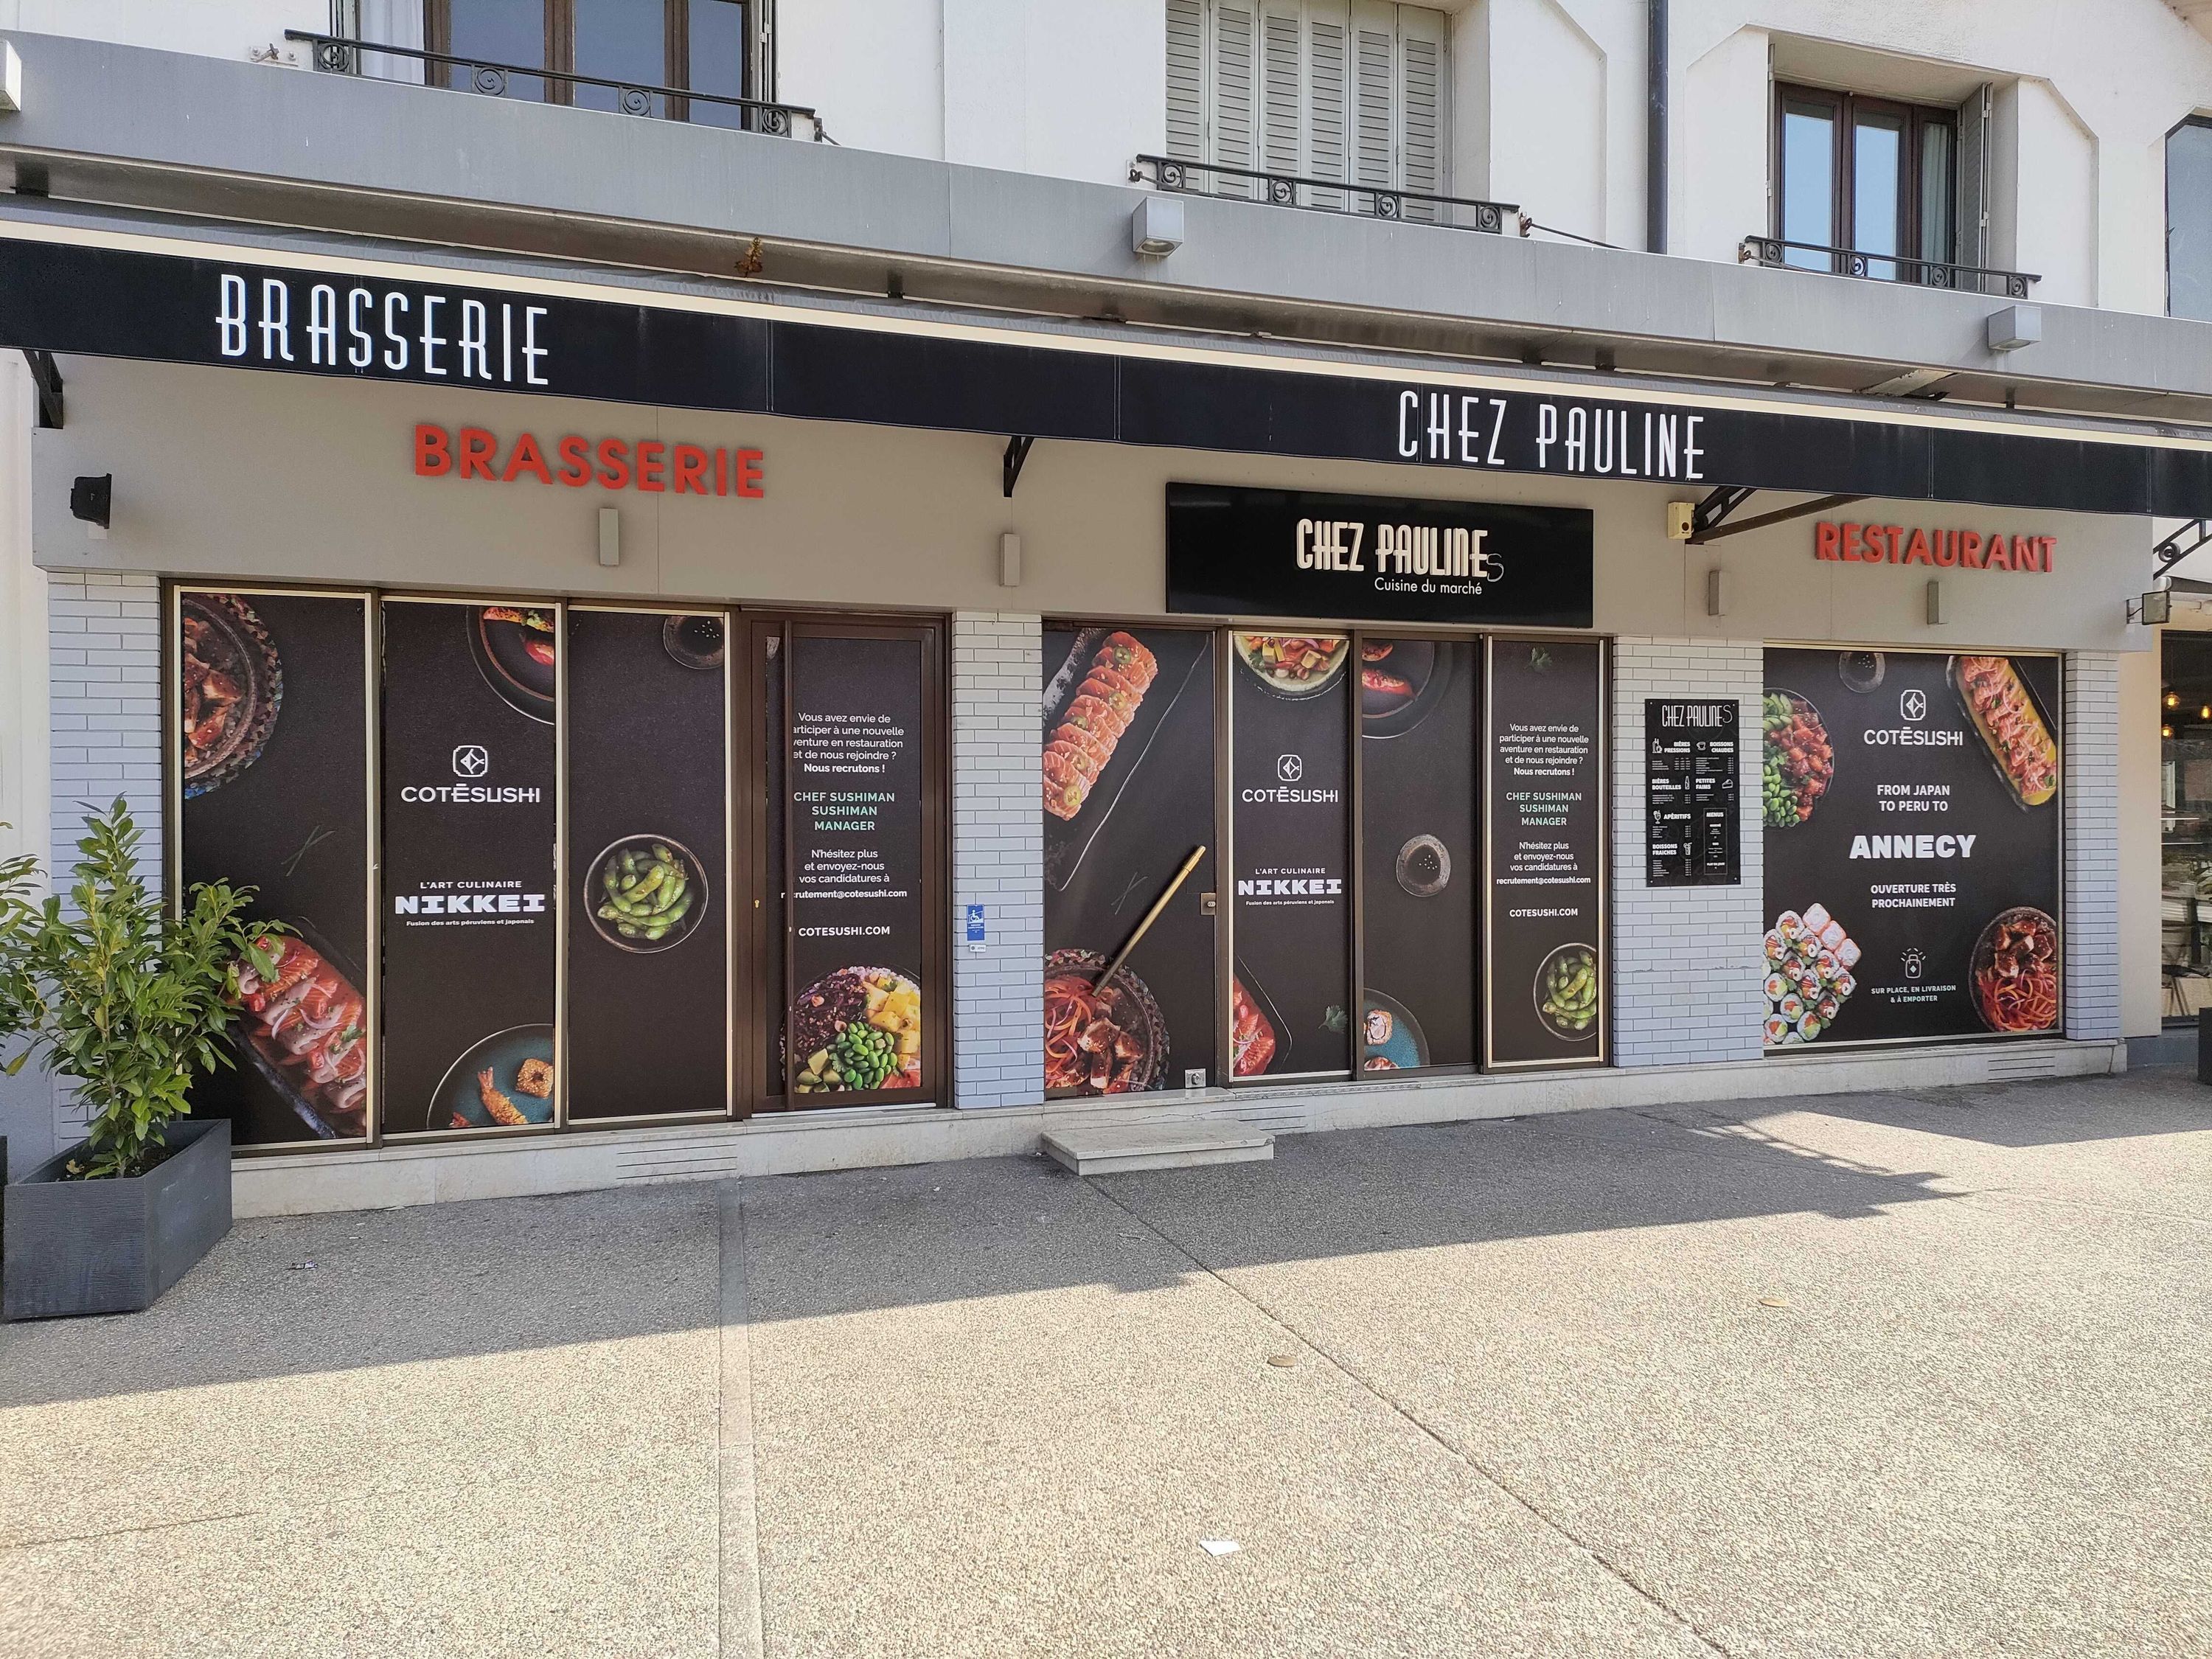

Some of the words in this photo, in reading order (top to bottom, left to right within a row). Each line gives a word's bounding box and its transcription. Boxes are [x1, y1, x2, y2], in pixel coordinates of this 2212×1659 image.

[216, 274, 549, 386] BRASSERIE
[1399, 390, 1506, 465] CHEZ
[1536, 404, 1705, 479] PAULINE
[414, 425, 765, 498] BRASSERIE
[1296, 518, 1364, 571] CHEZ
[1815, 521, 2057, 572] RESTAURANT
[1374, 577, 1417, 592] Cuisine
[1422, 579, 1436, 593] du
[1440, 581, 1482, 595] marché
[799, 713, 822, 722] Vous
[849, 714, 875, 723] envie
[878, 714, 891, 723] de
[1662, 705, 1685, 727] CHEZ
[793, 726, 831, 735] articiper
[833, 726, 839, 734] à
[863, 727, 904, 735] nouvelle
[1510, 723, 1528, 731] Vous
[1500, 734, 1534, 743] participer
[846, 740, 902, 748] restauration
[793, 751, 802, 759] et
[805, 751, 818, 759] de
[846, 751, 888, 761] rejoindre
[1545, 757, 1577, 765] rejoindre
[804, 764, 830, 772] Nous
[832, 764, 880, 772] recrutons
[1877, 785, 1910, 796] FROM
[1913, 785, 1950, 796] JAPAN
[794, 792, 826, 801] CHEF
[830, 793, 894, 802] SUSHIMAN
[1533, 793, 1582, 801] SUSHIMAN
[812, 806, 877, 815] SUSHIMAN
[1520, 804, 1568, 813] SUSHIMAN
[1879, 801, 1895, 811] TO
[1899, 801, 1929, 811] PERU
[1933, 801, 1948, 811] TO
[815, 821, 874, 830] MANAGER
[1554, 842, 1569, 851] plus
[1849, 835, 1976, 859] ANNECY
[811, 849, 855, 858] N'hésitez
[858, 849, 878, 860] plus
[1523, 853, 1573, 862] envoyez-nous
[804, 862, 815, 870] et
[817, 863, 884, 872] envoyez-nous
[1524, 863, 1571, 871] candidatures
[1573, 863, 1577, 871] à
[818, 874, 881, 883] candidatures
[884, 874, 889, 882] à
[1497, 877, 1590, 885] recrutement@cotesushi.com
[1239, 879, 1341, 895] NIKKEI
[1871, 883, 1930, 894] OUVERTURE
[1933, 882, 1956, 893] TRÈS
[781, 889, 907, 899] rrutement@cotesushi.com
[395, 894, 545, 914] NIKKEI
[1872, 897, 1955, 908] PROCHAINEMENT
[1509, 908, 1578, 917] COTESUSHI.COM
[799, 926, 890, 936] COTESUSHI.COM
